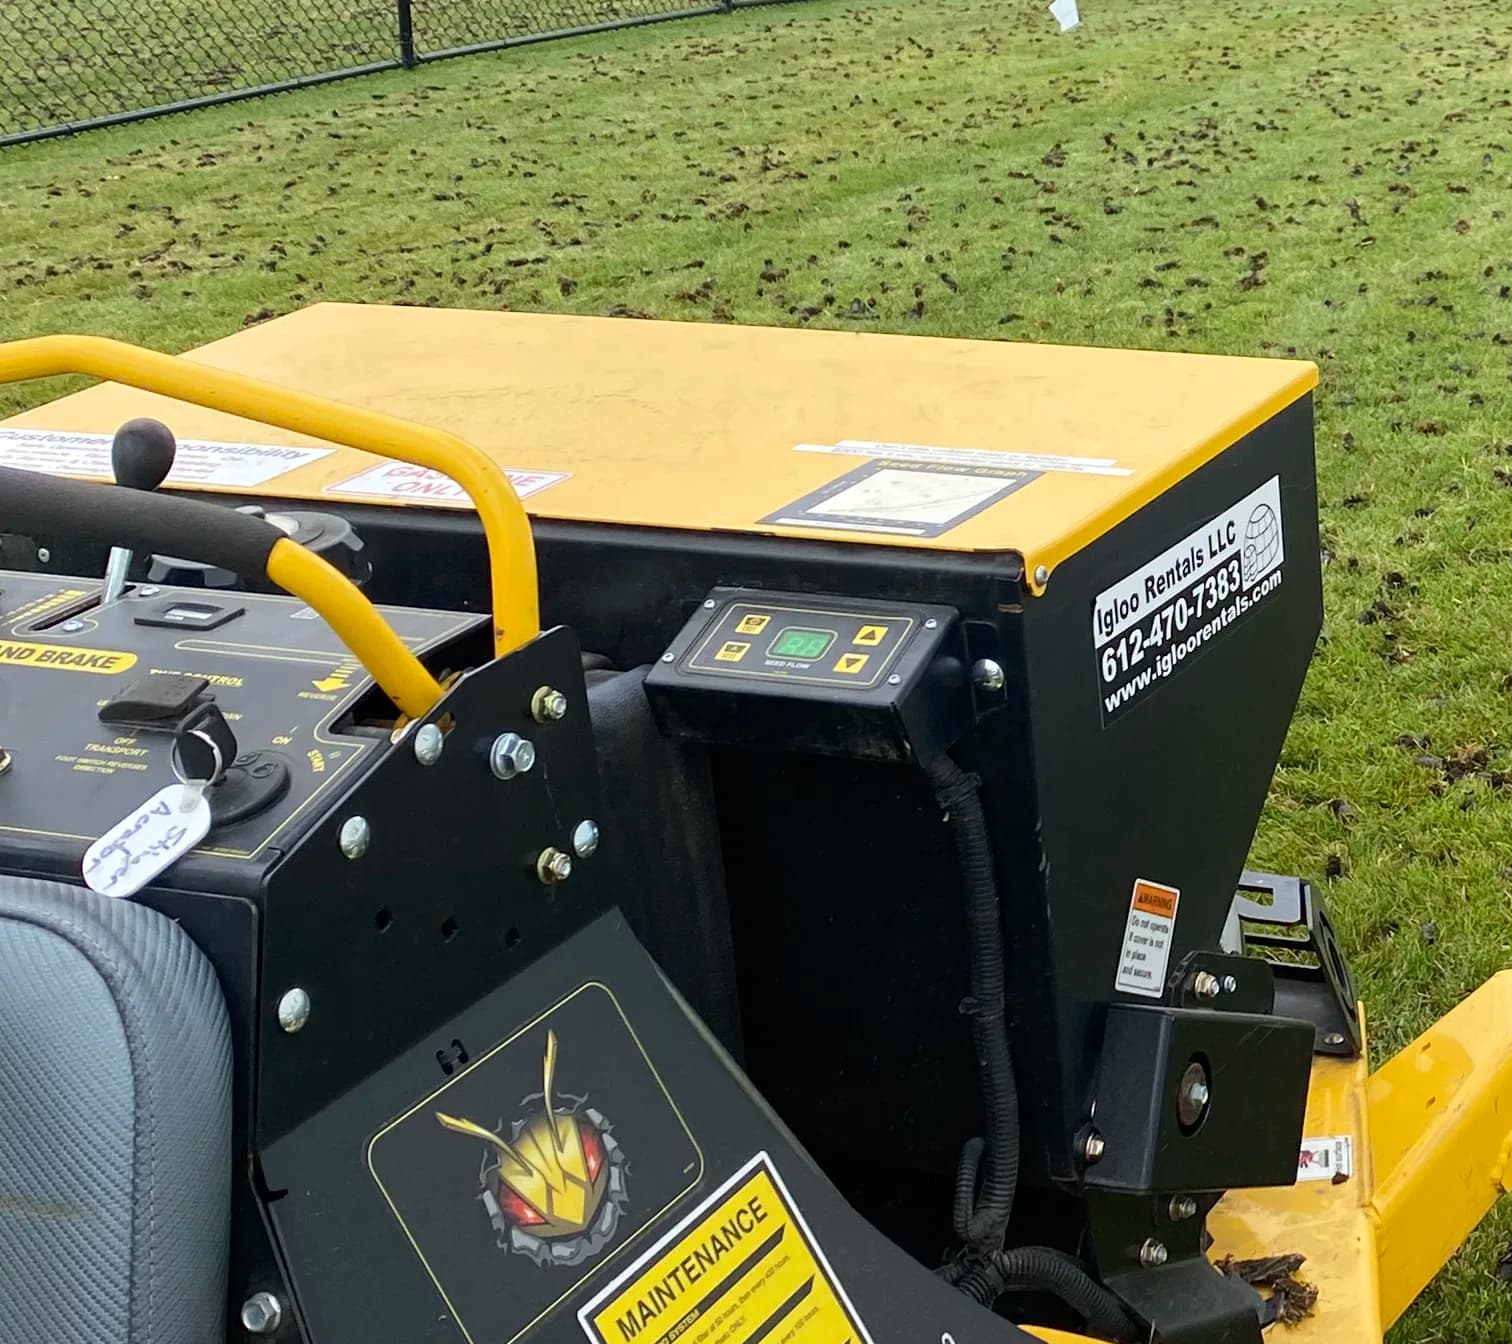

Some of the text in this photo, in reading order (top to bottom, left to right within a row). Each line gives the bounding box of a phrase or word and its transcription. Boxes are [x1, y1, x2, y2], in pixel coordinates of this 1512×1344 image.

[177, 443, 310, 460] onsibility
[974, 466, 1028, 479] Graph
[1096, 520, 1237, 638] Igloo Rentals LLC
[1101, 559, 1242, 683] 612-470-7383
[1104, 568, 1282, 714] www.igloorentals.com
[34, 649, 122, 671] BRAKE
[84, 743, 149, 757] TRANSPORT
[114, 736, 137, 745] OFF
[272, 735, 293, 745] ON
[615, 1195, 769, 1343] MAINTENANCE
[667, 1307, 700, 1342] SYSTEM
